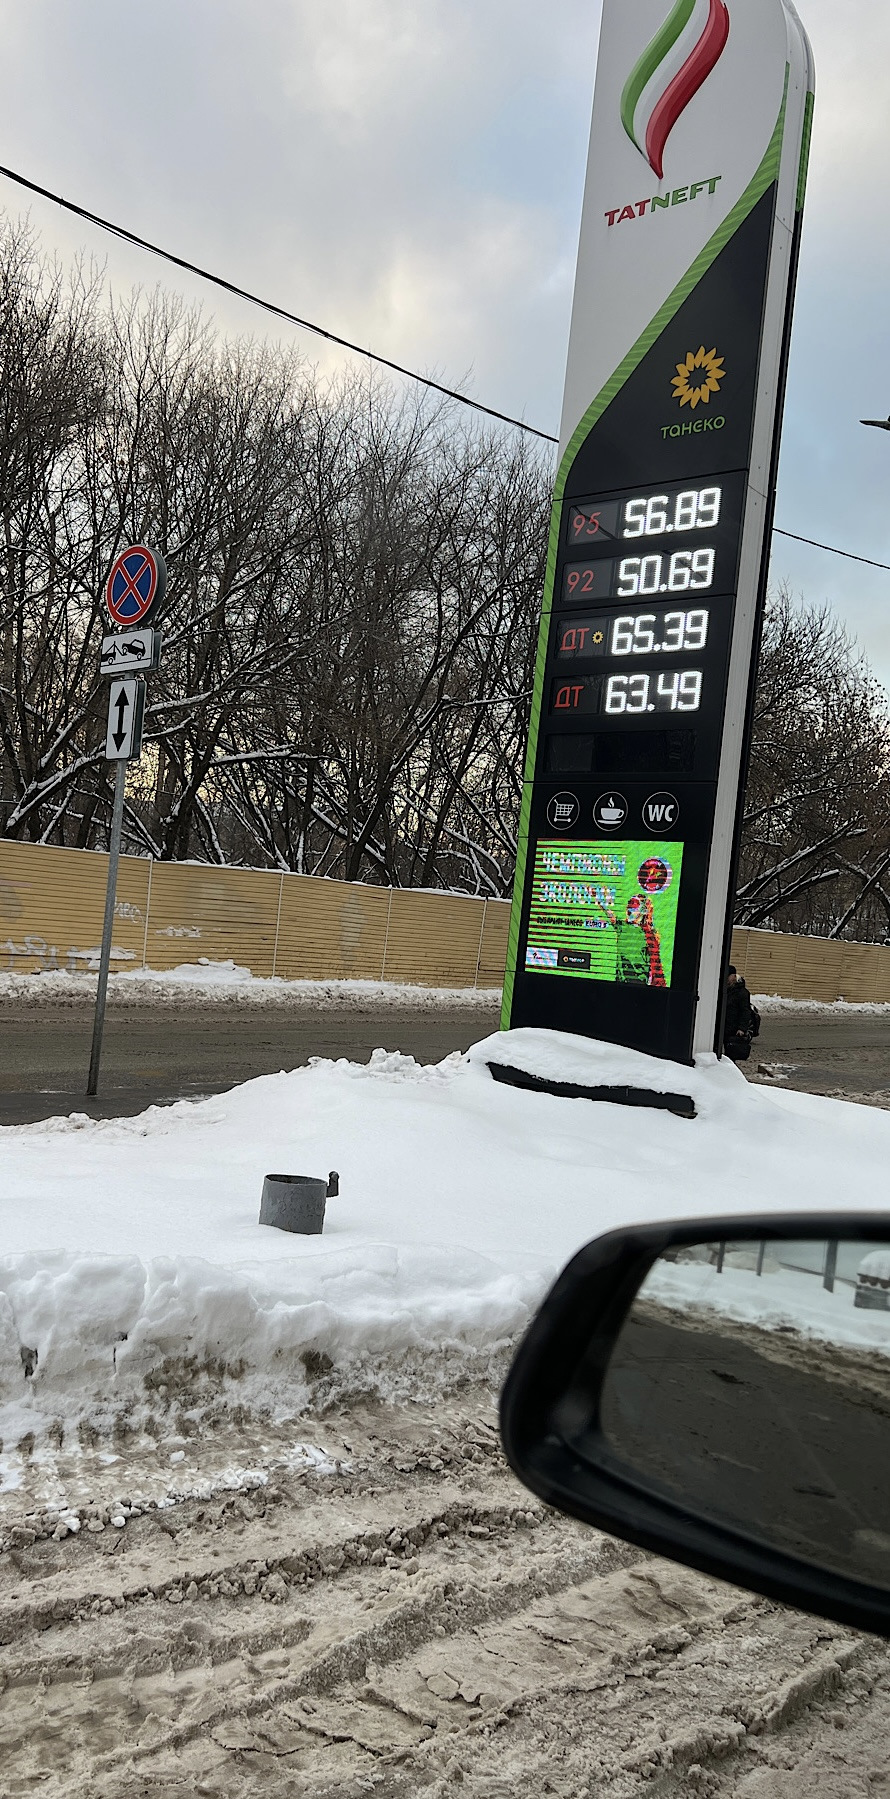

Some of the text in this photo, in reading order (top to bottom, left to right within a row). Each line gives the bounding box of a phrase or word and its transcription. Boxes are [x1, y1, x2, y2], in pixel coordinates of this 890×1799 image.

[604, 175, 722, 227] TATNEFT
[572, 487, 722, 538] 95 56.89
[567, 548, 715, 596] 92 50.69
[560, 609, 710, 655] ДТ 65.39
[554, 671, 703, 713] ДТ 63.49
[648, 804, 674, 822] WC
